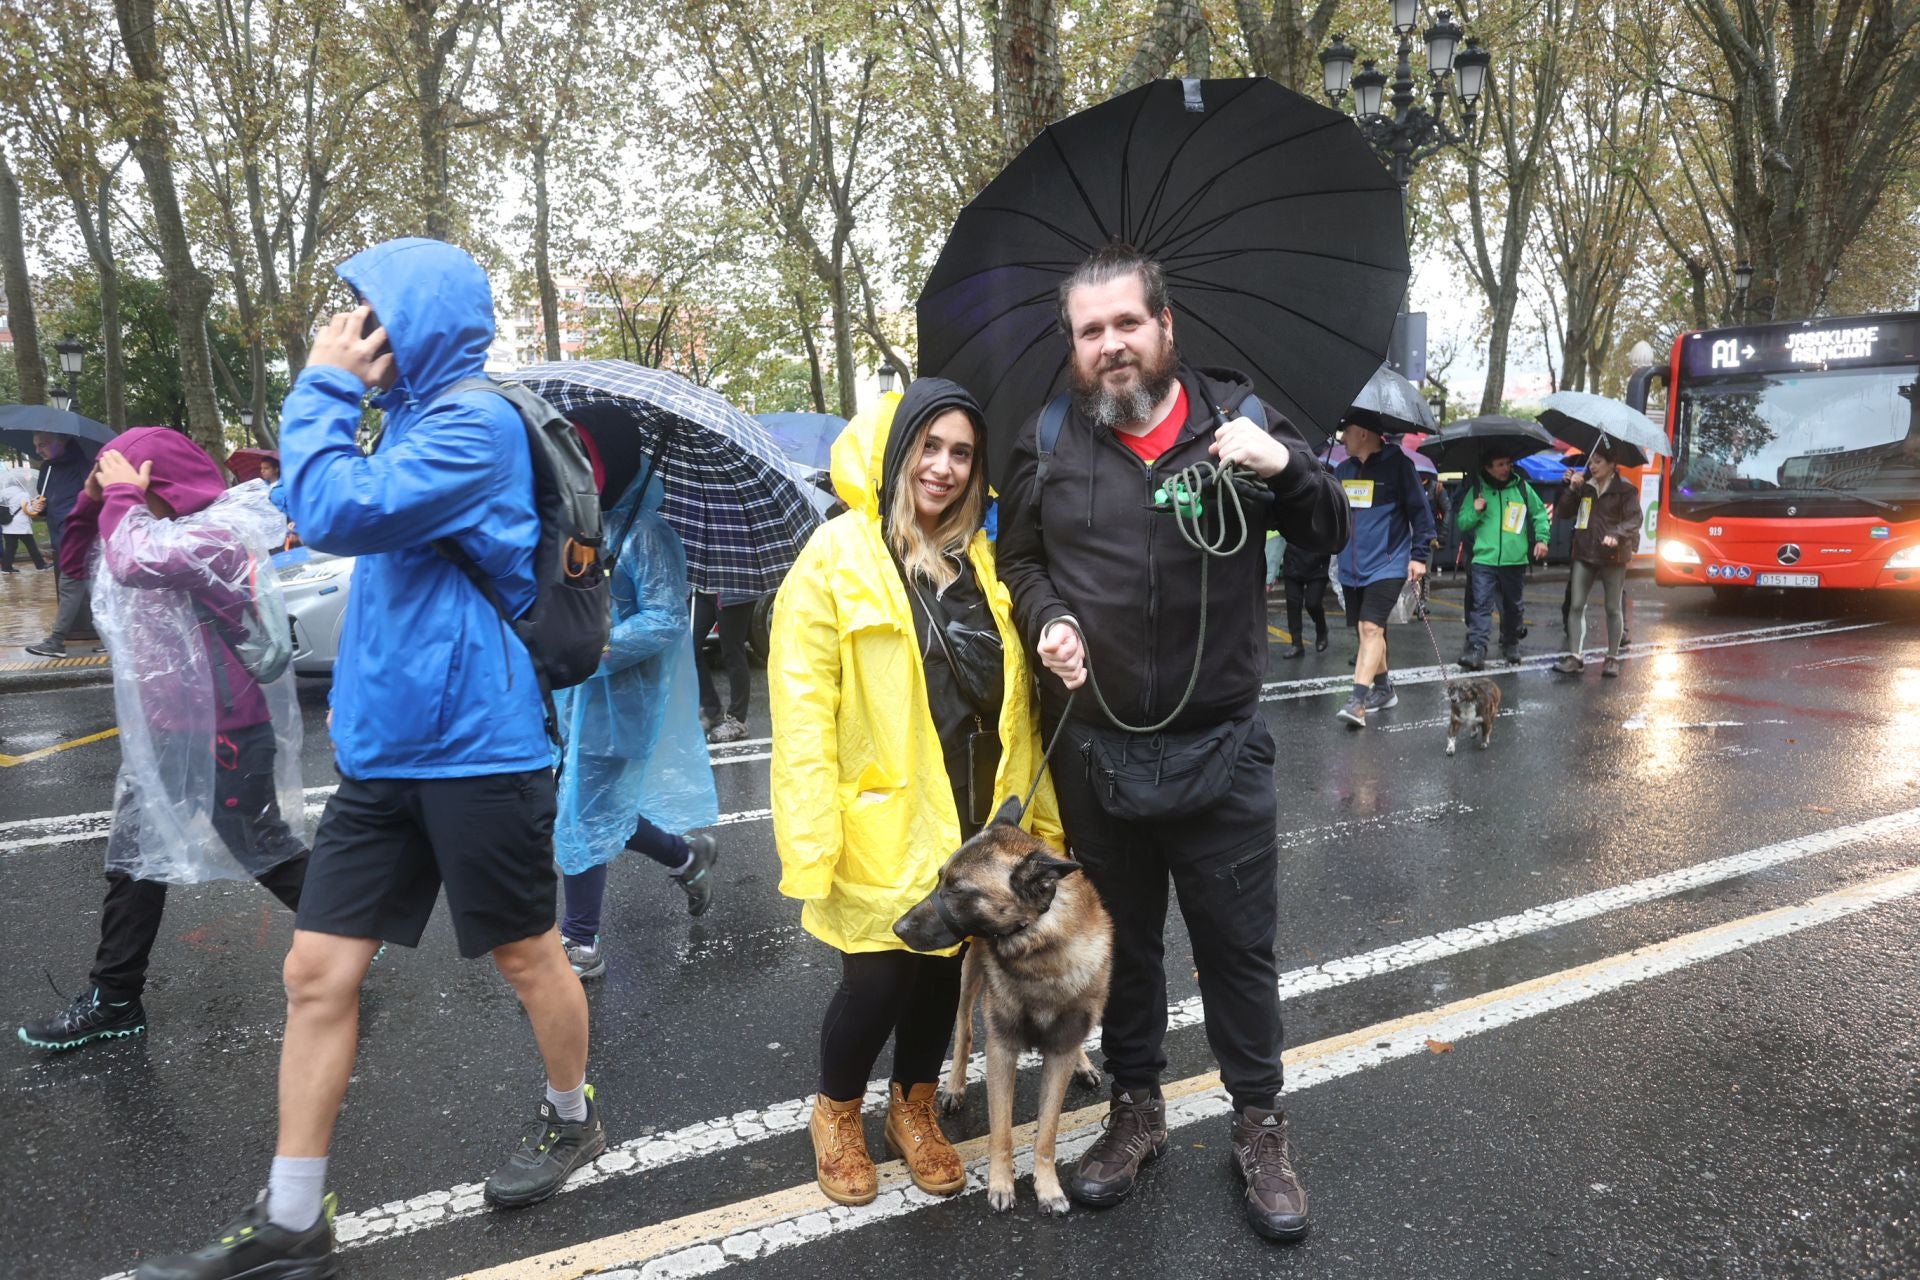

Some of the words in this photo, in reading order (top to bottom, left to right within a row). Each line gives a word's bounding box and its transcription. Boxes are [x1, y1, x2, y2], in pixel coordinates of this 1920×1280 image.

[1785, 326, 1879, 349] JASOKUNDE
[1712, 338, 1740, 369] A1
[1792, 341, 1872, 363] ASUNCION
[1709, 526, 1723, 536] 919
[1762, 575, 1787, 585] 0151
[1795, 576, 1817, 586] LRB
